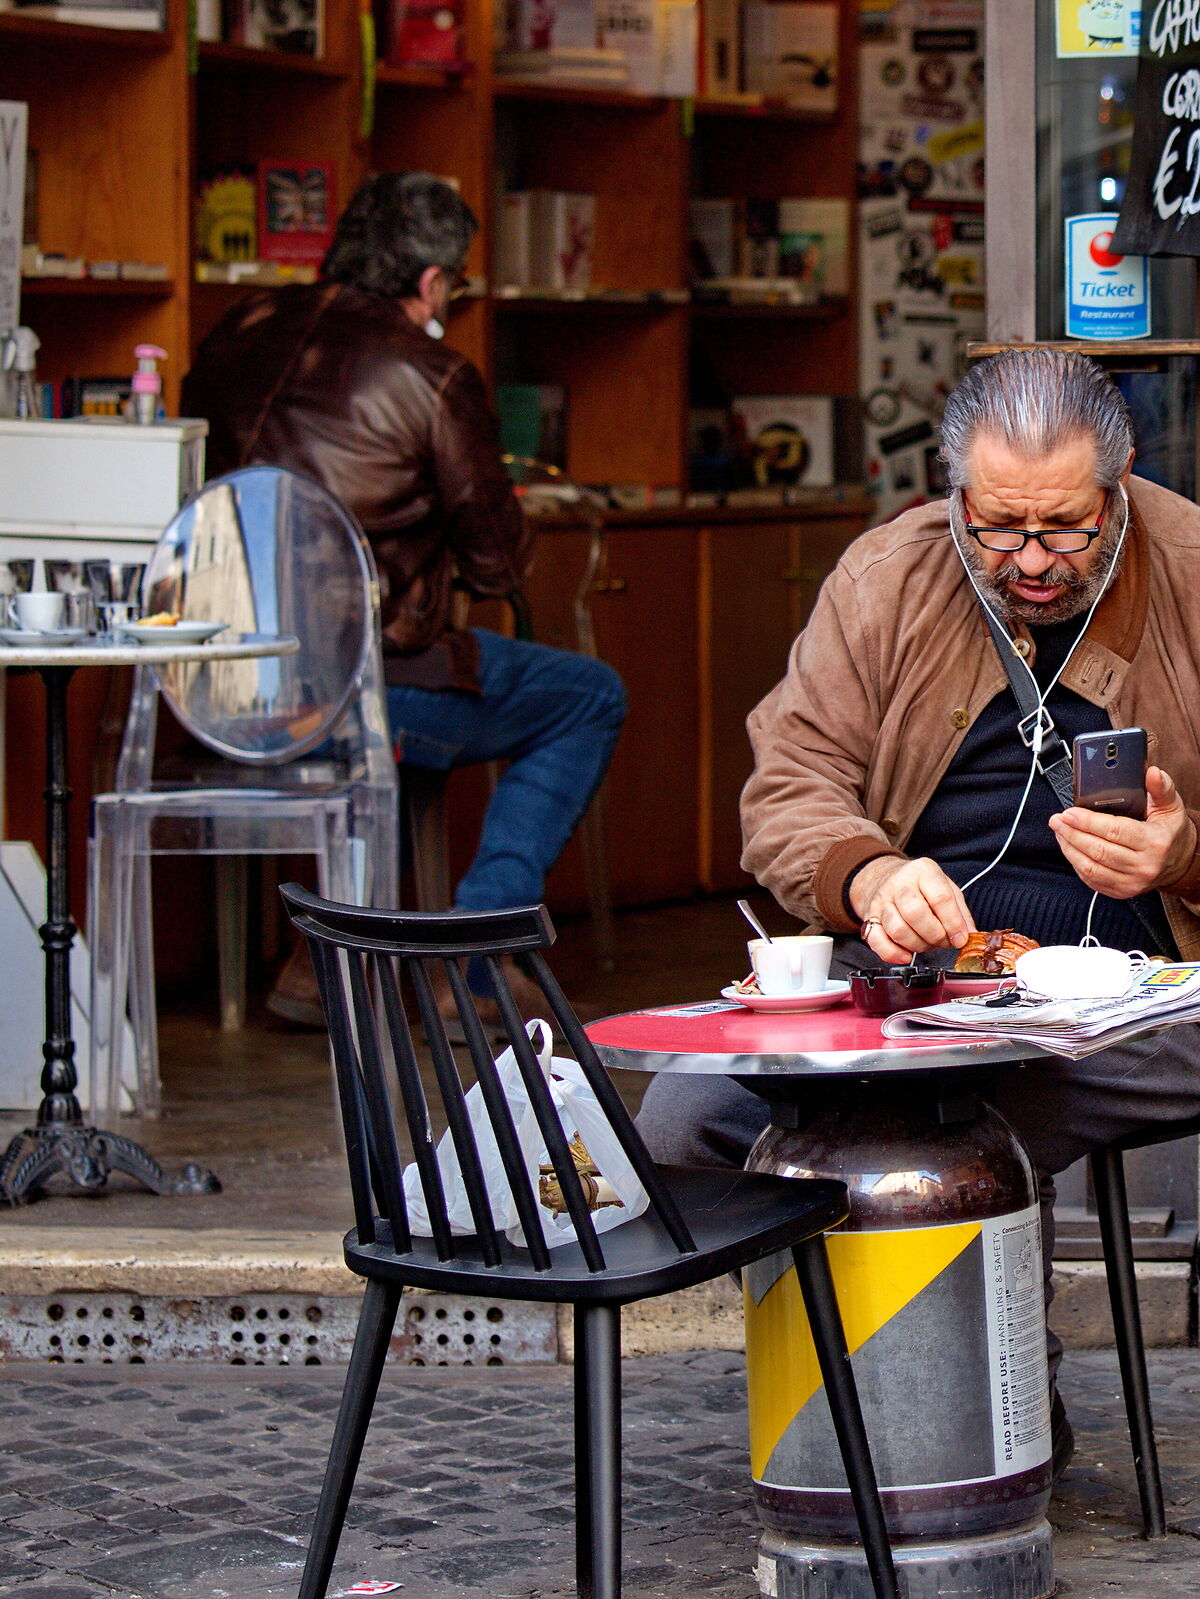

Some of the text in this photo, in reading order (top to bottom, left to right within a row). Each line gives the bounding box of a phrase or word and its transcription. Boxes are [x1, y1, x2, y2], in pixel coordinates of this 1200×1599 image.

[1079, 282, 1136, 298] Ticket
[1080, 310, 1136, 320] Restaurant
[992, 1232, 1013, 1461] READ BEFORE USE: HANDLING & SAFETY
